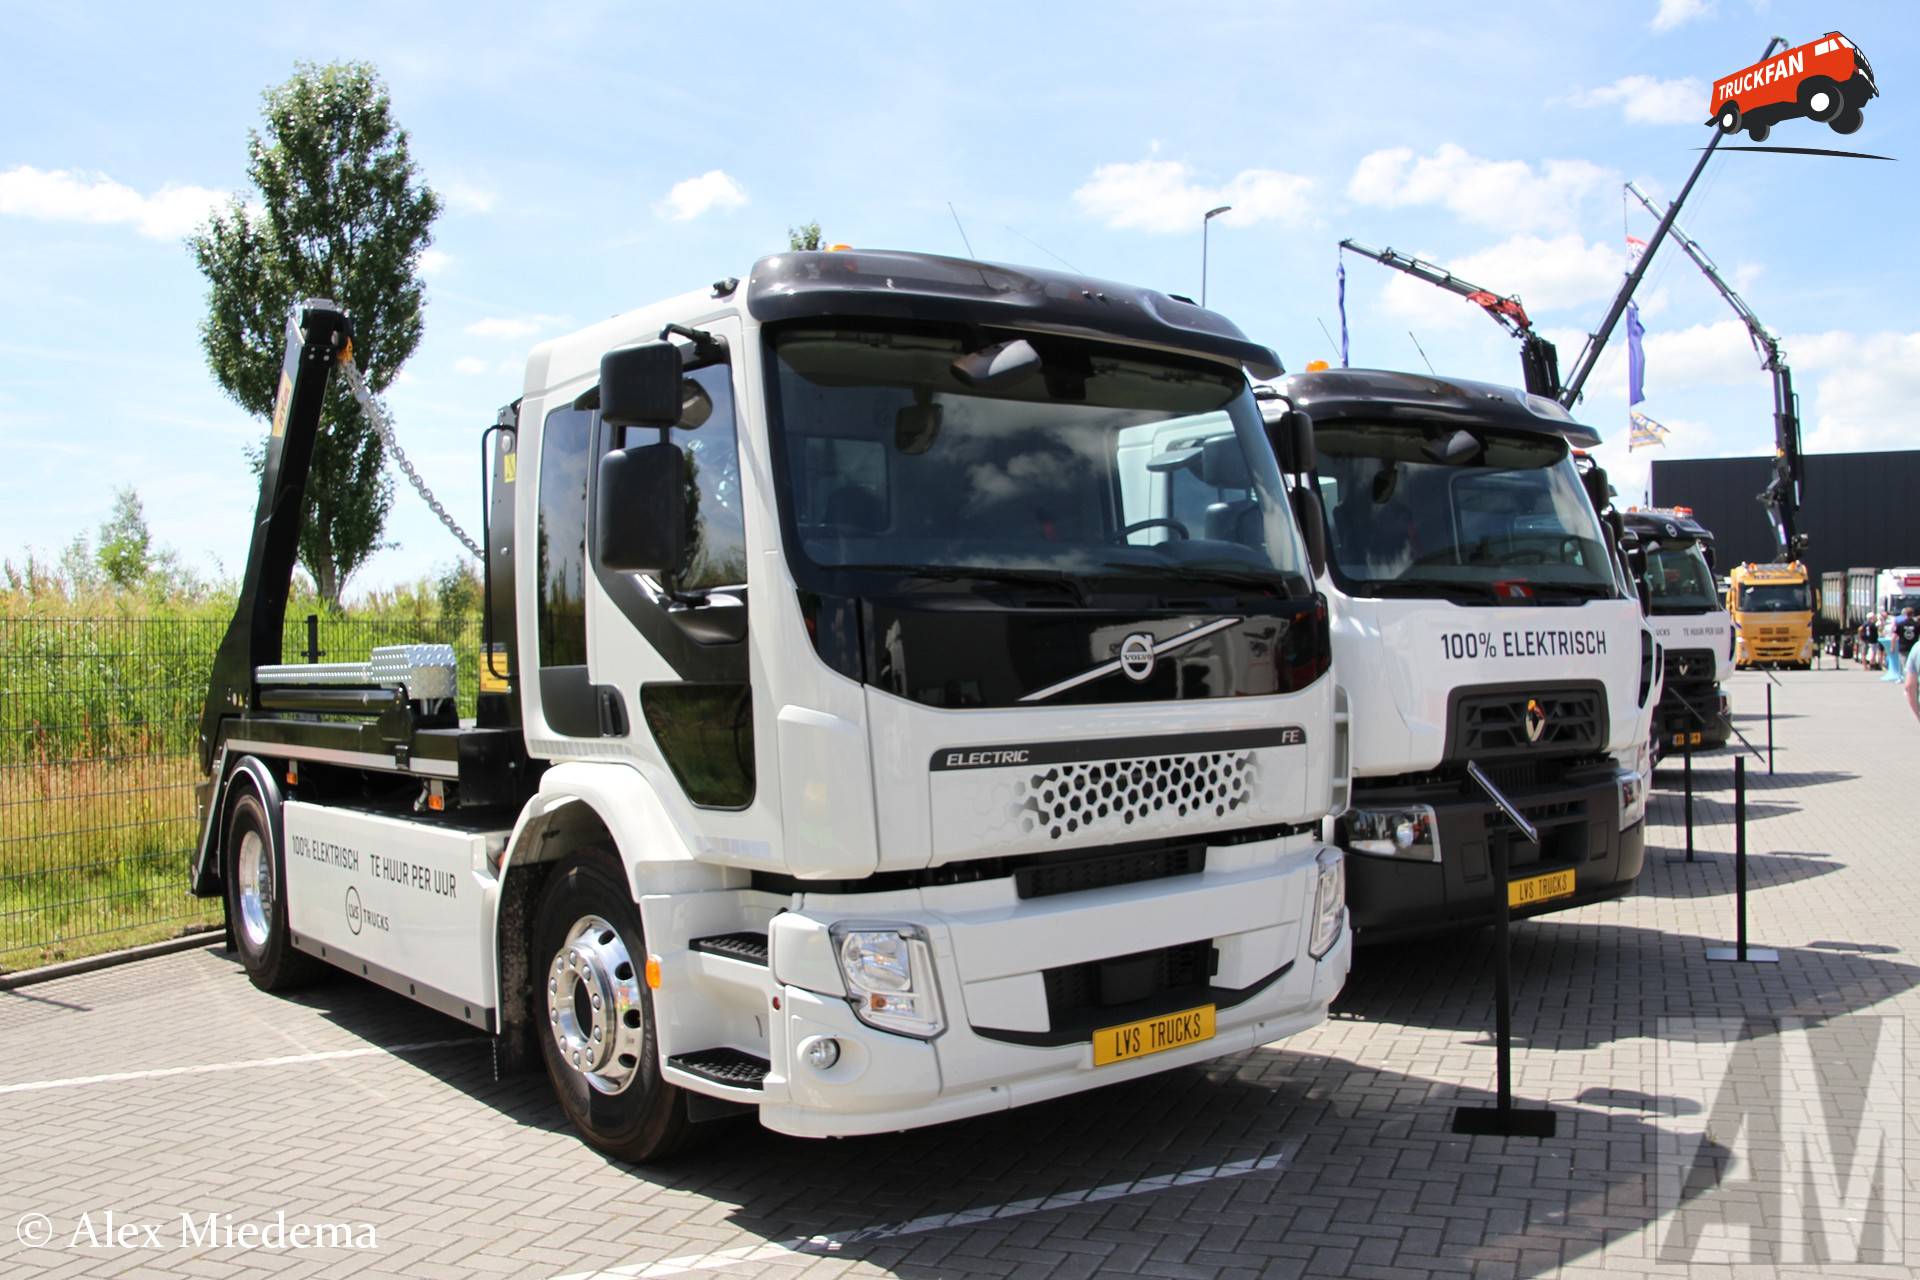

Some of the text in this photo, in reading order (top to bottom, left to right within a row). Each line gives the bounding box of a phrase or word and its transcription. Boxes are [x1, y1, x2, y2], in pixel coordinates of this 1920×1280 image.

[1441, 630, 1607, 660] 100% ELEKTRISCH
[1281, 730, 1300, 744] FE
[946, 750, 1029, 767] ELECTRIC
[292, 835, 359, 872] 100% ELEKTRISCH
[370, 854, 457, 899] TE HUUR PER UUR
[1519, 873, 1567, 901] LVS TRUCKS
[363, 908, 389, 932] TRUCKS
[1115, 1012, 1201, 1057] LVS TRUCKS
